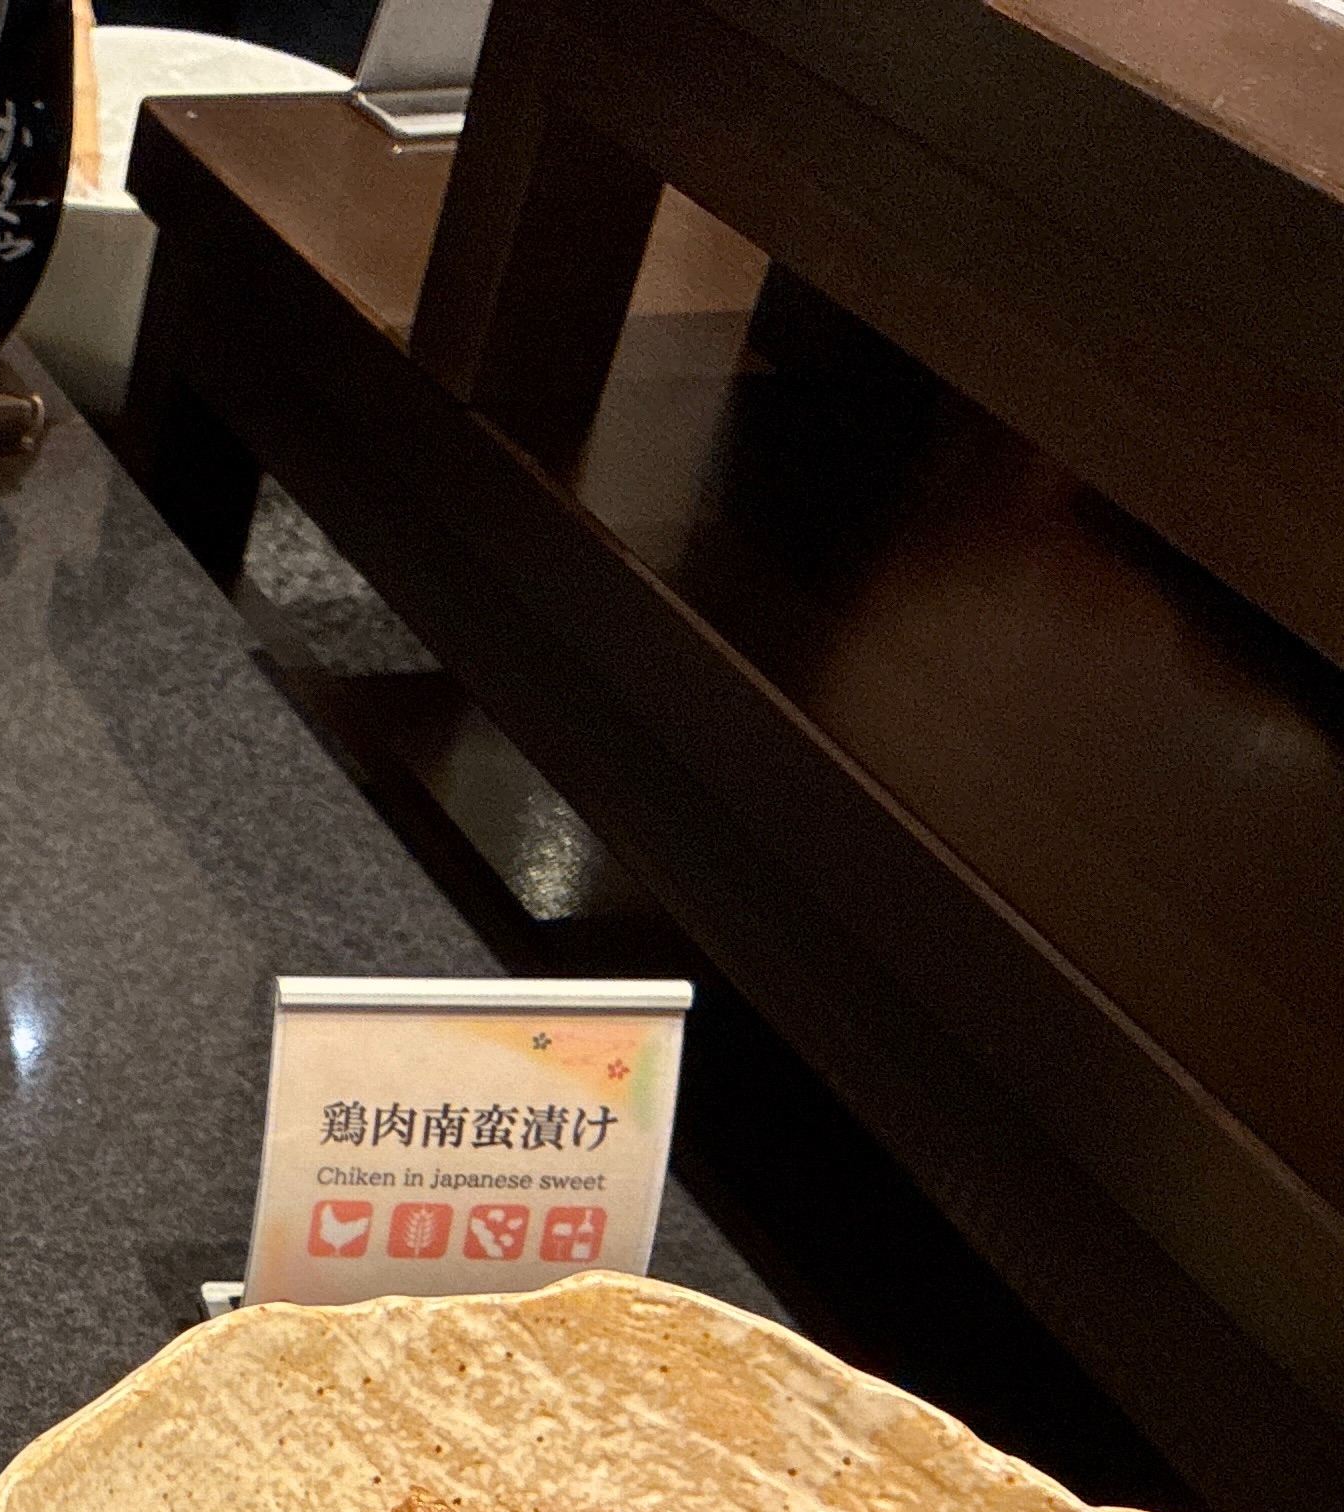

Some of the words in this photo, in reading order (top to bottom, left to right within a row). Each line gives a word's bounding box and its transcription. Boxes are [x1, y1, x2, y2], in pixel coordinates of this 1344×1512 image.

[319, 1099, 619, 1151] 鶏肉南蛮漬け
[316, 1166, 395, 1187] Chiken
[403, 1168, 424, 1188] in
[429, 1168, 533, 1190] japanese
[539, 1173, 608, 1192] sweet
